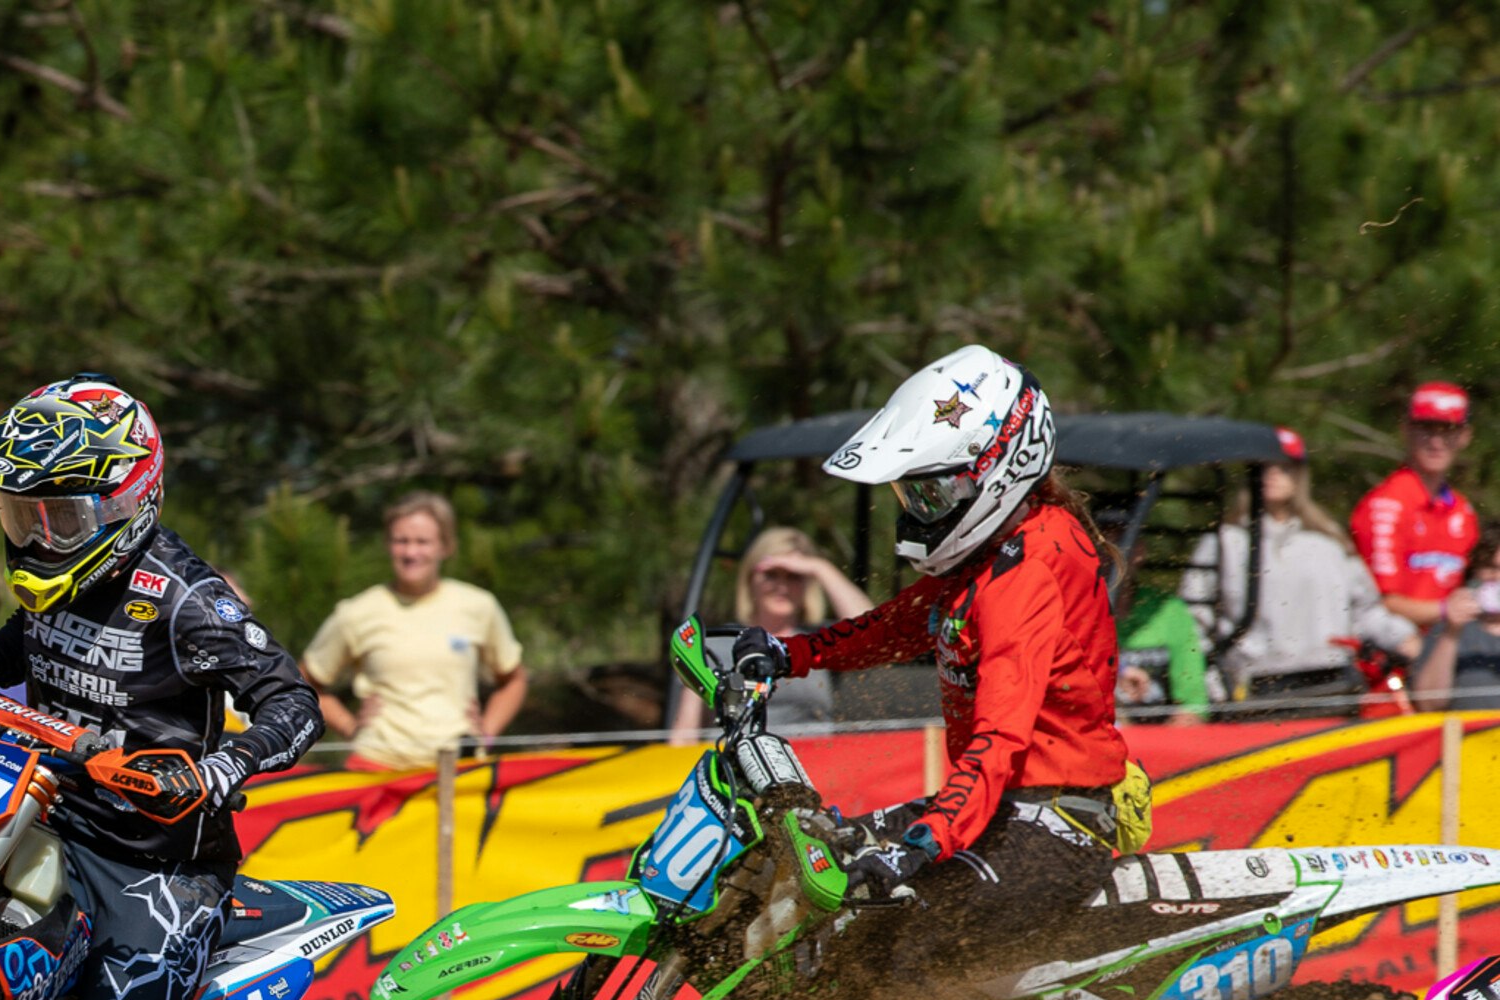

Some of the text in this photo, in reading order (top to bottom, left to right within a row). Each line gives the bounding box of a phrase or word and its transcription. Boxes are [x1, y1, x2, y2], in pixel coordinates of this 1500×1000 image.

[956, 443, 1004, 481] LOW
[987, 449, 1033, 500] 310
[133, 570, 167, 592] RK
[25, 620, 145, 672] RACING
[47, 677, 129, 707] JESTERS
[49, 659, 129, 697] TRAIL
[109, 772, 156, 793] ACERBIS
[300, 918, 356, 957] DUNLOP
[437, 955, 493, 979] ACERBIS
